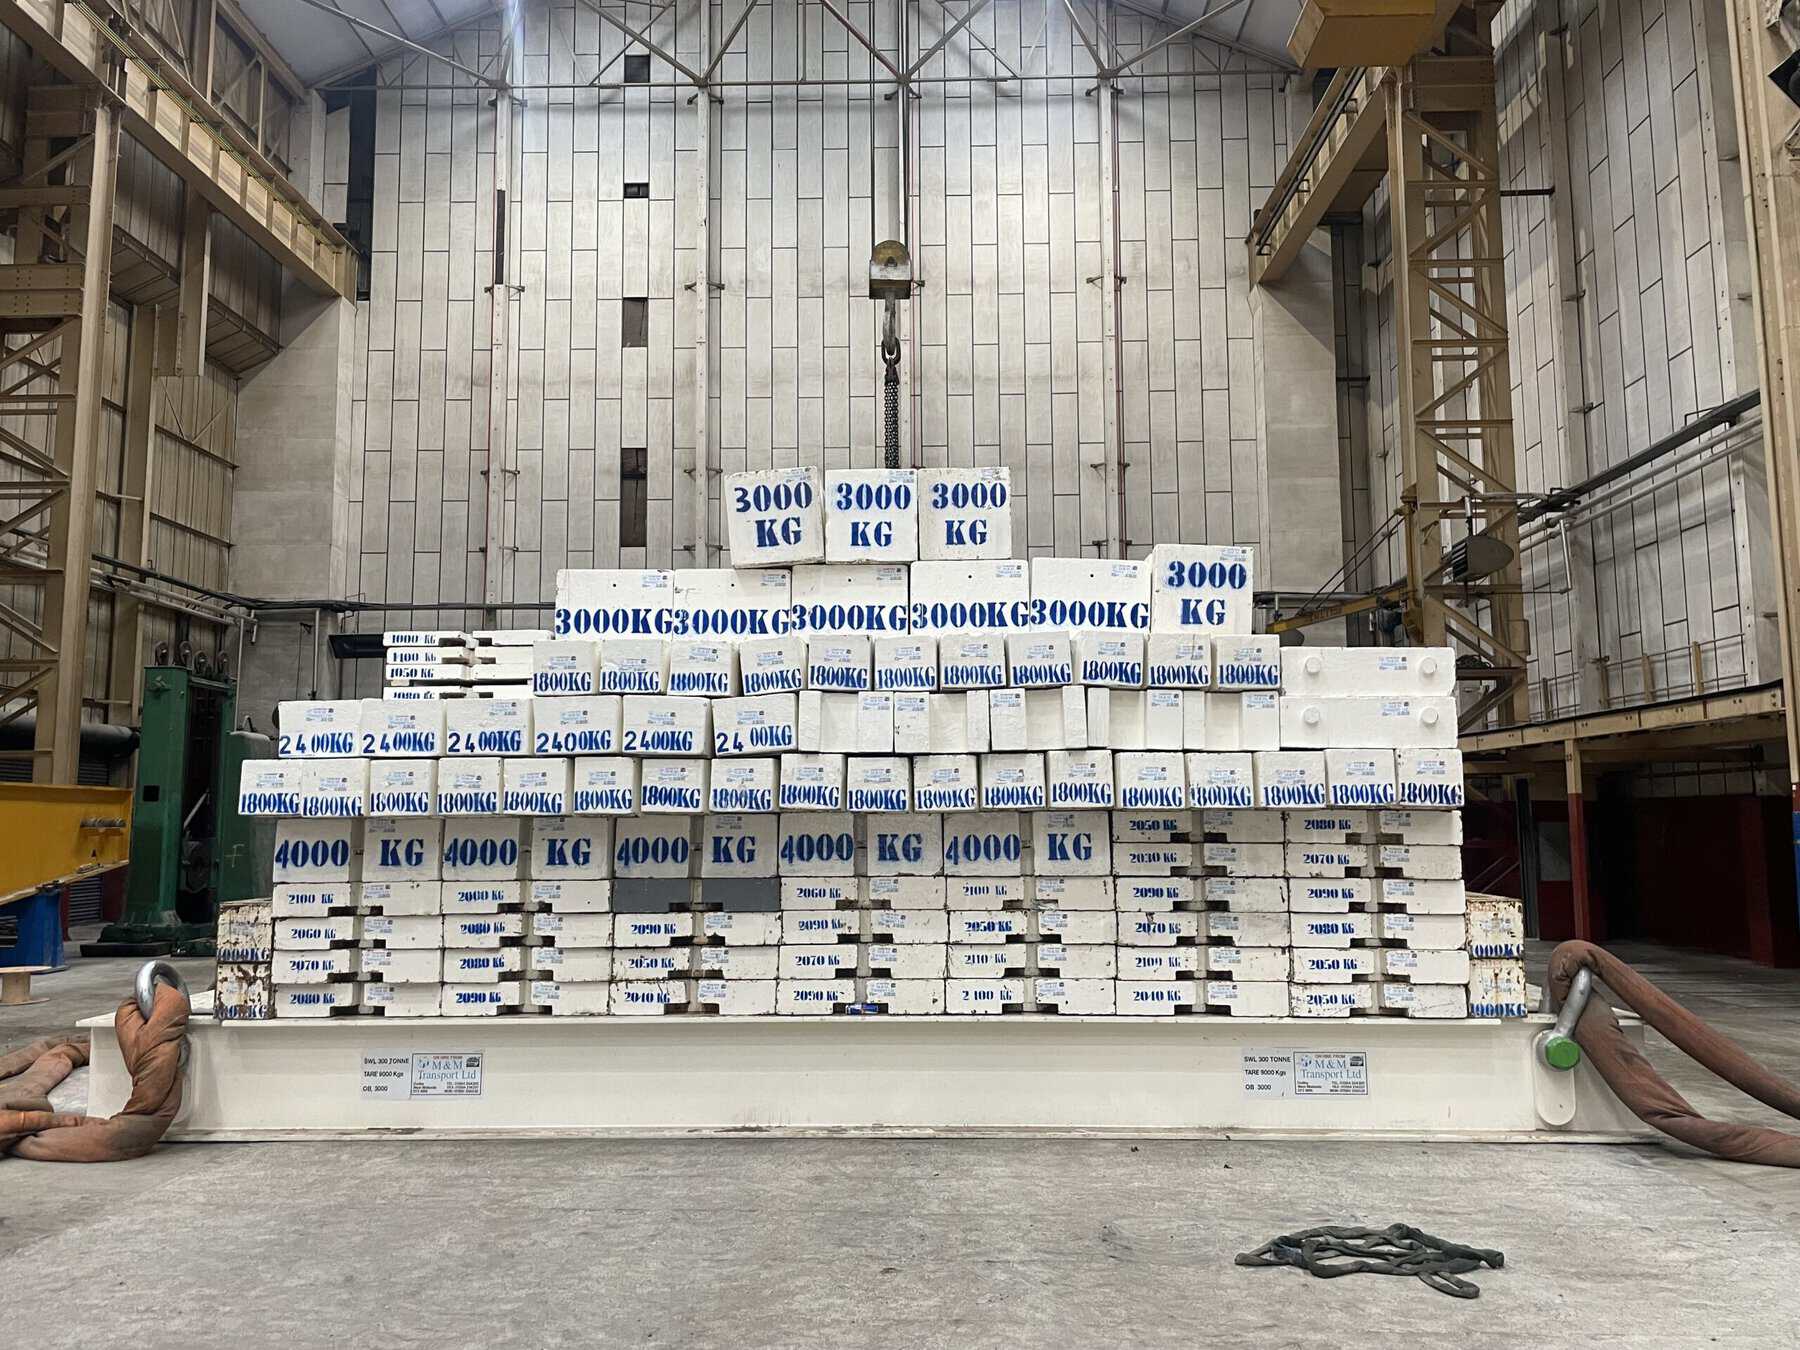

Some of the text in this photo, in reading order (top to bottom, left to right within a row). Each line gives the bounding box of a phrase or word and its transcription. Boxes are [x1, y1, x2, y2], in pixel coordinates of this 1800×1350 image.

[736, 482, 812, 512] 3000
[837, 481, 911, 510] 3000
[932, 483, 1006, 509] 3000
[755, 517, 802, 547] KG
[851, 521, 892, 547] KG
[945, 520, 987, 545] KG
[1168, 561, 1246, 589] 3000
[672, 608, 792, 635] 3000KG
[790, 605, 908, 630] 3000KG
[912, 602, 1030, 628] 3000KG
[1029, 599, 1150, 628] 3000KG
[1181, 599, 1225, 624] KG
[554, 609, 674, 635] 3000KG
[532, 672, 591, 692] 1800KG
[602, 670, 658, 692] 1800KG
[671, 673, 727, 692] 1800KG
[743, 669, 801, 693] 1800KG
[810, 666, 868, 690] 1800KG
[876, 667, 936, 689] 1800KG
[944, 665, 1002, 686] 1800KG
[1013, 664, 1071, 686] 1800KG
[1083, 661, 1141, 684] 1800KG
[1149, 665, 1208, 686] 1800KG
[1220, 665, 1278, 685] 1800KG
[371, 792, 428, 813] 1800KG
[436, 792, 496, 813] 1800KG
[502, 791, 562, 814] 1800KG
[574, 789, 632, 811] 1800KG
[640, 786, 700, 808] 1800KG
[713, 789, 771, 812] 1800KG
[780, 785, 839, 807] 1800KG
[849, 790, 906, 812] 1800KG
[917, 789, 975, 809] 1800KG
[985, 786, 1043, 806] 1800KG
[1053, 783, 1111, 804] 1800KG
[1123, 787, 1182, 807] 1800KG
[1189, 786, 1251, 808] 1800KG
[1264, 782, 1325, 806] 1800KG
[1332, 784, 1394, 806] 1800KG
[1401, 783, 1461, 805] 1800KG
[240, 793, 299, 815] 1800KG
[303, 797, 362, 817] 1800KG
[1129, 820, 1177, 830] 2050 KG
[1304, 819, 1350, 829] 2080 KG
[275, 840, 423, 868] 4000 KG
[444, 838, 591, 867] 4000 KG
[617, 836, 755, 867] 4000 KG
[781, 833, 922, 863] 4000 KG
[946, 833, 1092, 865] 4000 KG
[1164, 853, 1177, 863] KG
[1303, 854, 1350, 864] 2070 KG
[288, 894, 333, 904] 2100 KG
[492, 890, 503, 900] KG
[797, 888, 840, 898] 2060 KG
[963, 886, 1007, 895] 2100 KG
[1133, 887, 1179, 898] 2090 KG
[1308, 888, 1354, 898] 2090 KG
[291, 929, 335, 938] 2060 KG
[494, 922, 505, 932] KG
[631, 924, 676, 934] 2090 KG
[799, 919, 843, 930] 2090 KG
[965, 922, 1012, 931] 2050 KG
[1136, 922, 1181, 933] 2070 KG
[1308, 924, 1354, 934] 2080 KG
[290, 960, 334, 970] 2070 KG
[460, 957, 504, 969] 2080 KG
[628, 959, 674, 968] 2050 KG
[796, 955, 839, 965] 2070 KG
[965, 954, 1006, 964] 2110 KG
[1168, 957, 1180, 967] KG
[1309, 960, 1358, 969] 2050 KG
[290, 993, 335, 1004] 2080 KG
[456, 992, 501, 1003] 2090 KG
[624, 992, 670, 1002] 2040 KG
[827, 991, 838, 1000] KG
[1000, 991, 1012, 1000] KG
[1133, 991, 1181, 1001] 2040 KG
[1307, 994, 1355, 1004] 2050 KG
[418, 1070, 476, 1081] Transport Ltd
[1302, 1069, 1361, 1080] Transport Ltd
